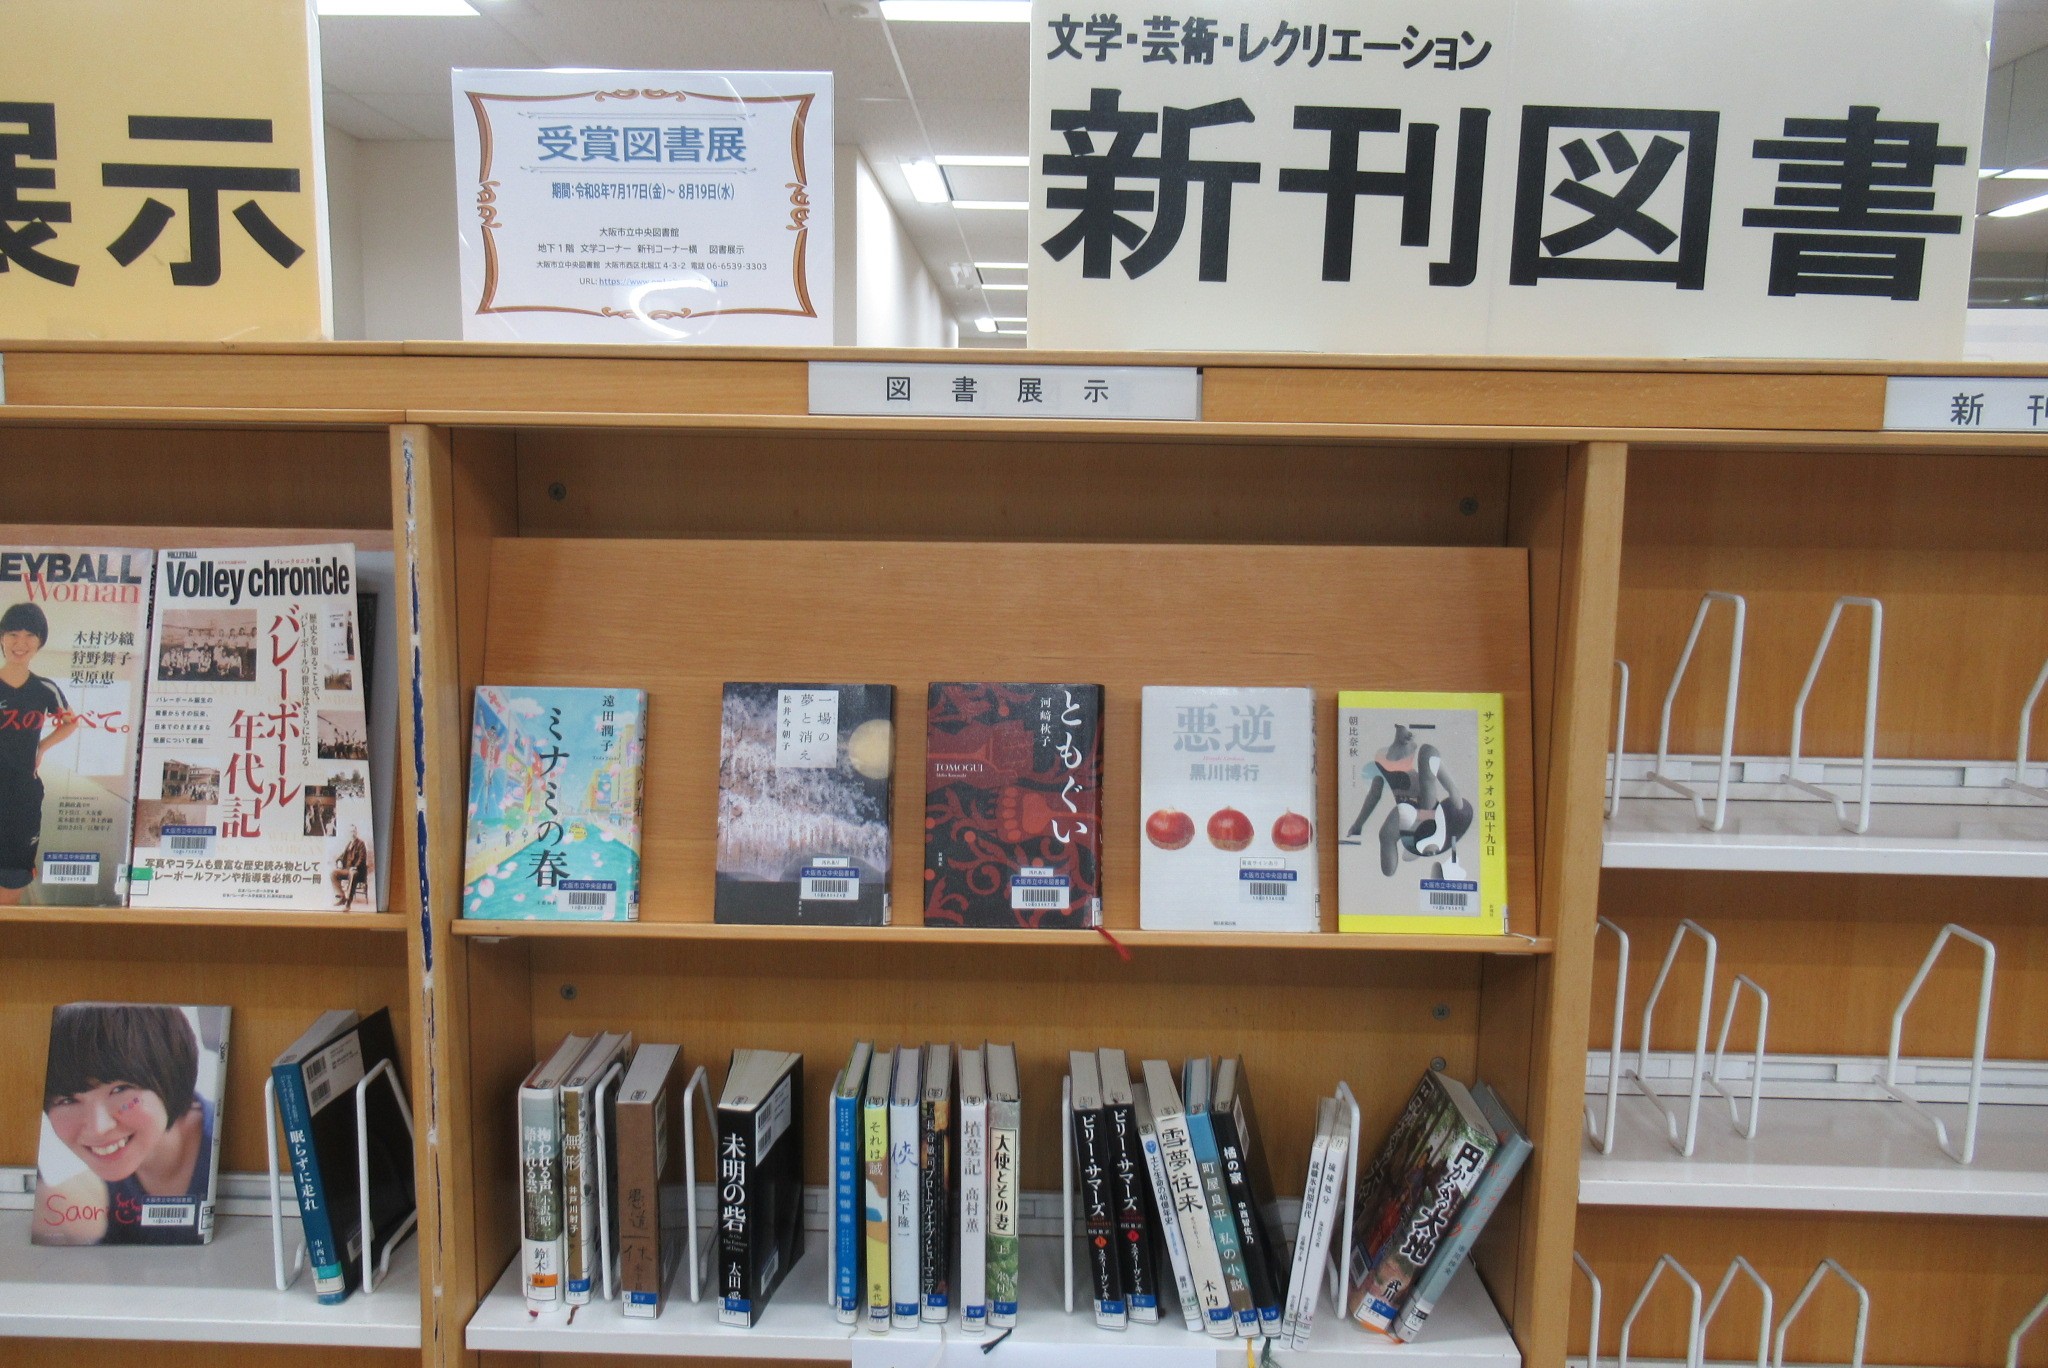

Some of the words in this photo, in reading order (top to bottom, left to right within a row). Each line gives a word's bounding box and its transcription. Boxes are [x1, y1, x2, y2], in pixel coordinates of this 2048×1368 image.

[1046, 14, 1492, 73] 文学・芸術・レクリエーション
[537, 124, 747, 163] 受賞図書展
[678, 183, 735, 201] 8月19日(水)
[1041, 88, 1969, 302] 新刊図書
[580, 244, 631, 254] 文学コーナー
[637, 244, 698, 255] 新刊コーナー横
[709, 245, 745, 255] 図書展示
[599, 228, 679, 238] 大阪市立中央図書館
[536, 260, 600, 269] 大阪市立中央図書館
[706, 262, 768, 271] 06-6539-3303
[579, 278, 598, 286] URL:
[886, 376, 1109, 403] 図書展示
[21, 572, 141, 604] Woman
[166, 560, 245, 605] Volley
[249, 557, 350, 597] chronicle
[72, 651, 132, 666] 狩野舞子
[74, 630, 134, 646] 木村沙織
[70, 671, 115, 685] 栗原恵
[261, 603, 302, 808] バレーボール
[600, 694, 615, 753] 遠田潤子
[781, 694, 792, 751] 松井今朝子
[799, 692, 815, 761] 夢と消え
[818, 696, 833, 742] 一場の
[1172, 703, 1277, 753] 悪逆
[1348, 715, 1359, 757] 朝比奈秋
[221, 708, 267, 838] 年代記
[935, 763, 983, 773] TOMOGUI
[1051, 690, 1088, 843] ともぐい
[1189, 763, 1260, 782] 黒川博行
[1482, 711, 1496, 857] サンショウウオの四十九日
[525, 707, 571, 888] ミナミの春
[145, 858, 320, 873] 写真やコラムも豊富な歴史読み物として
[150, 871, 322, 885] レーボールファンや指導者必携の一冊
[290, 1130, 318, 1211] 眠らずに走れ
[565, 1134, 581, 1171] 無形
[869, 1121, 883, 1175] それは誠
[1082, 1114, 1106, 1217] ビリー・サマーズ
[1113, 1109, 1138, 1211] ビリー・サマーズ
[1162, 1127, 1203, 1213] 雪夢往来
[1223, 1146, 1243, 1184] 橘の家
[721, 1132, 747, 1233] 未明の砦
[994, 1133, 1011, 1231] 大使とその妻
[1151, 1155, 1173, 1225] 土と生命の46億年史
[1202, 1162, 1228, 1222] 町屋良平
[1399, 1141, 1485, 1267] 円かなる大地
[568, 1186, 579, 1234] 井戸川射子
[898, 1188, 910, 1236] 松下隆一
[966, 1187, 979, 1233] 高村薫
[1238, 1201, 1254, 1244] 中西智佐乃
[1098, 1249, 1110, 1301] スティーヴン・キ
[1131, 1243, 1143, 1295] スティーヴン・キ
[1219, 1232, 1245, 1292] 私の小説
[1382, 1279, 1402, 1303] 武川
